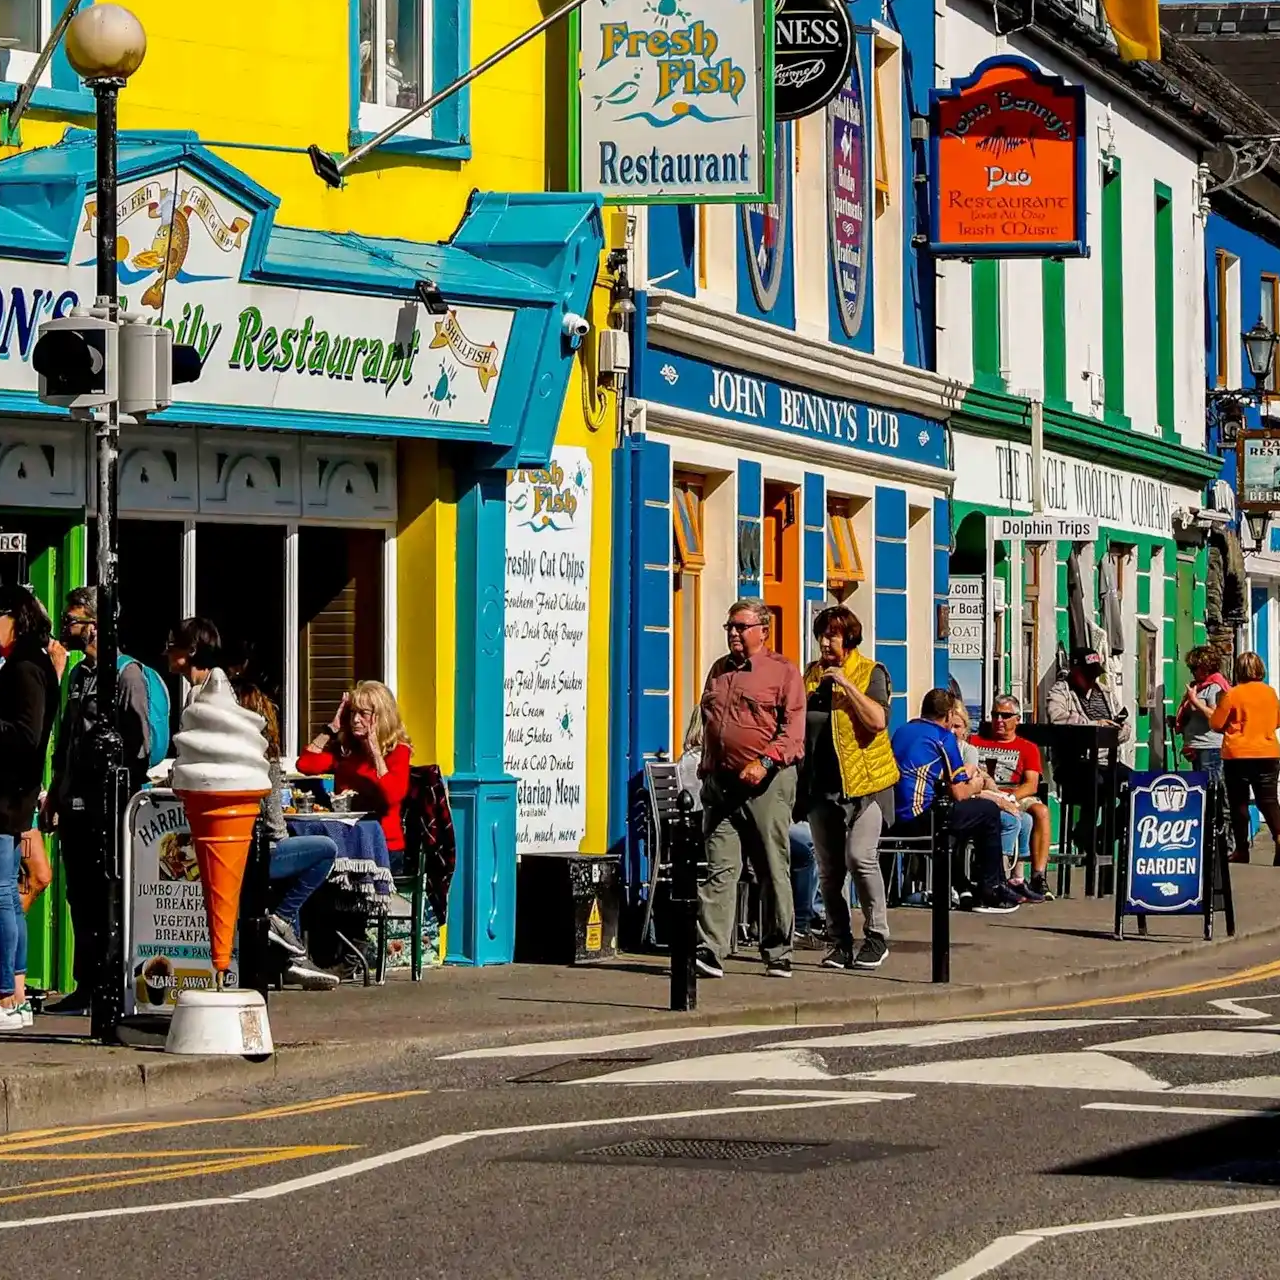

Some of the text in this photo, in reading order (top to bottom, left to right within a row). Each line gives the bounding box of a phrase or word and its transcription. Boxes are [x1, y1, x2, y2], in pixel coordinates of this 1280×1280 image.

[776, 20, 840, 44] NESS
[596, 20, 719, 70] Fresh
[652, 58, 746, 107] Fish
[599, 141, 749, 184] Restaurant
[984, 166, 1032, 191] Pub
[131, 186, 152, 206] Fish
[189, 191, 233, 247] Freshly Cut Chips
[229, 307, 422, 397] Restaurant
[445, 319, 491, 363] SHELLFISH
[709, 370, 900, 448] JOHN BENNY'S PUB
[996, 446, 1021, 500] THE
[1026, 452, 1067, 510] DGLE
[1074, 464, 1124, 521] WOOLLEN
[532, 486, 577, 523] Fish
[1250, 491, 1280, 501] BEER
[1003, 521, 1090, 537] Dolphin Trips
[505, 549, 584, 585] reshly Cut Chips
[536, 592, 557, 614] Fried
[559, 593, 585, 611] Chicken
[505, 621, 583, 646] 00% Irish Beef Burger
[950, 644, 980, 654] RIPS
[504, 677, 514, 696] eep
[516, 671, 534, 696] Fried
[557, 671, 582, 694] Snickers
[506, 702, 544, 717] Ice Cream
[505, 727, 552, 746] Milk Shakes
[505, 755, 573, 770] Hot & Cold Drinks
[518, 777, 580, 809] etarian Menu
[519, 807, 546, 817] Available
[516, 826, 531, 843] uch,
[559, 829, 577, 842] more
[1137, 815, 1198, 850] Beer
[1136, 857, 1196, 875] GARDEN
[138, 885, 173, 897] JUMBO
[183, 885, 203, 898] FUL
[156, 898, 205, 911] BREAKFA
[153, 914, 208, 927] VEGETAR
[155, 929, 210, 942] BREAKFA
[138, 945, 179, 957] WAFFLES
[152, 975, 210, 988] TAKE AWAY
